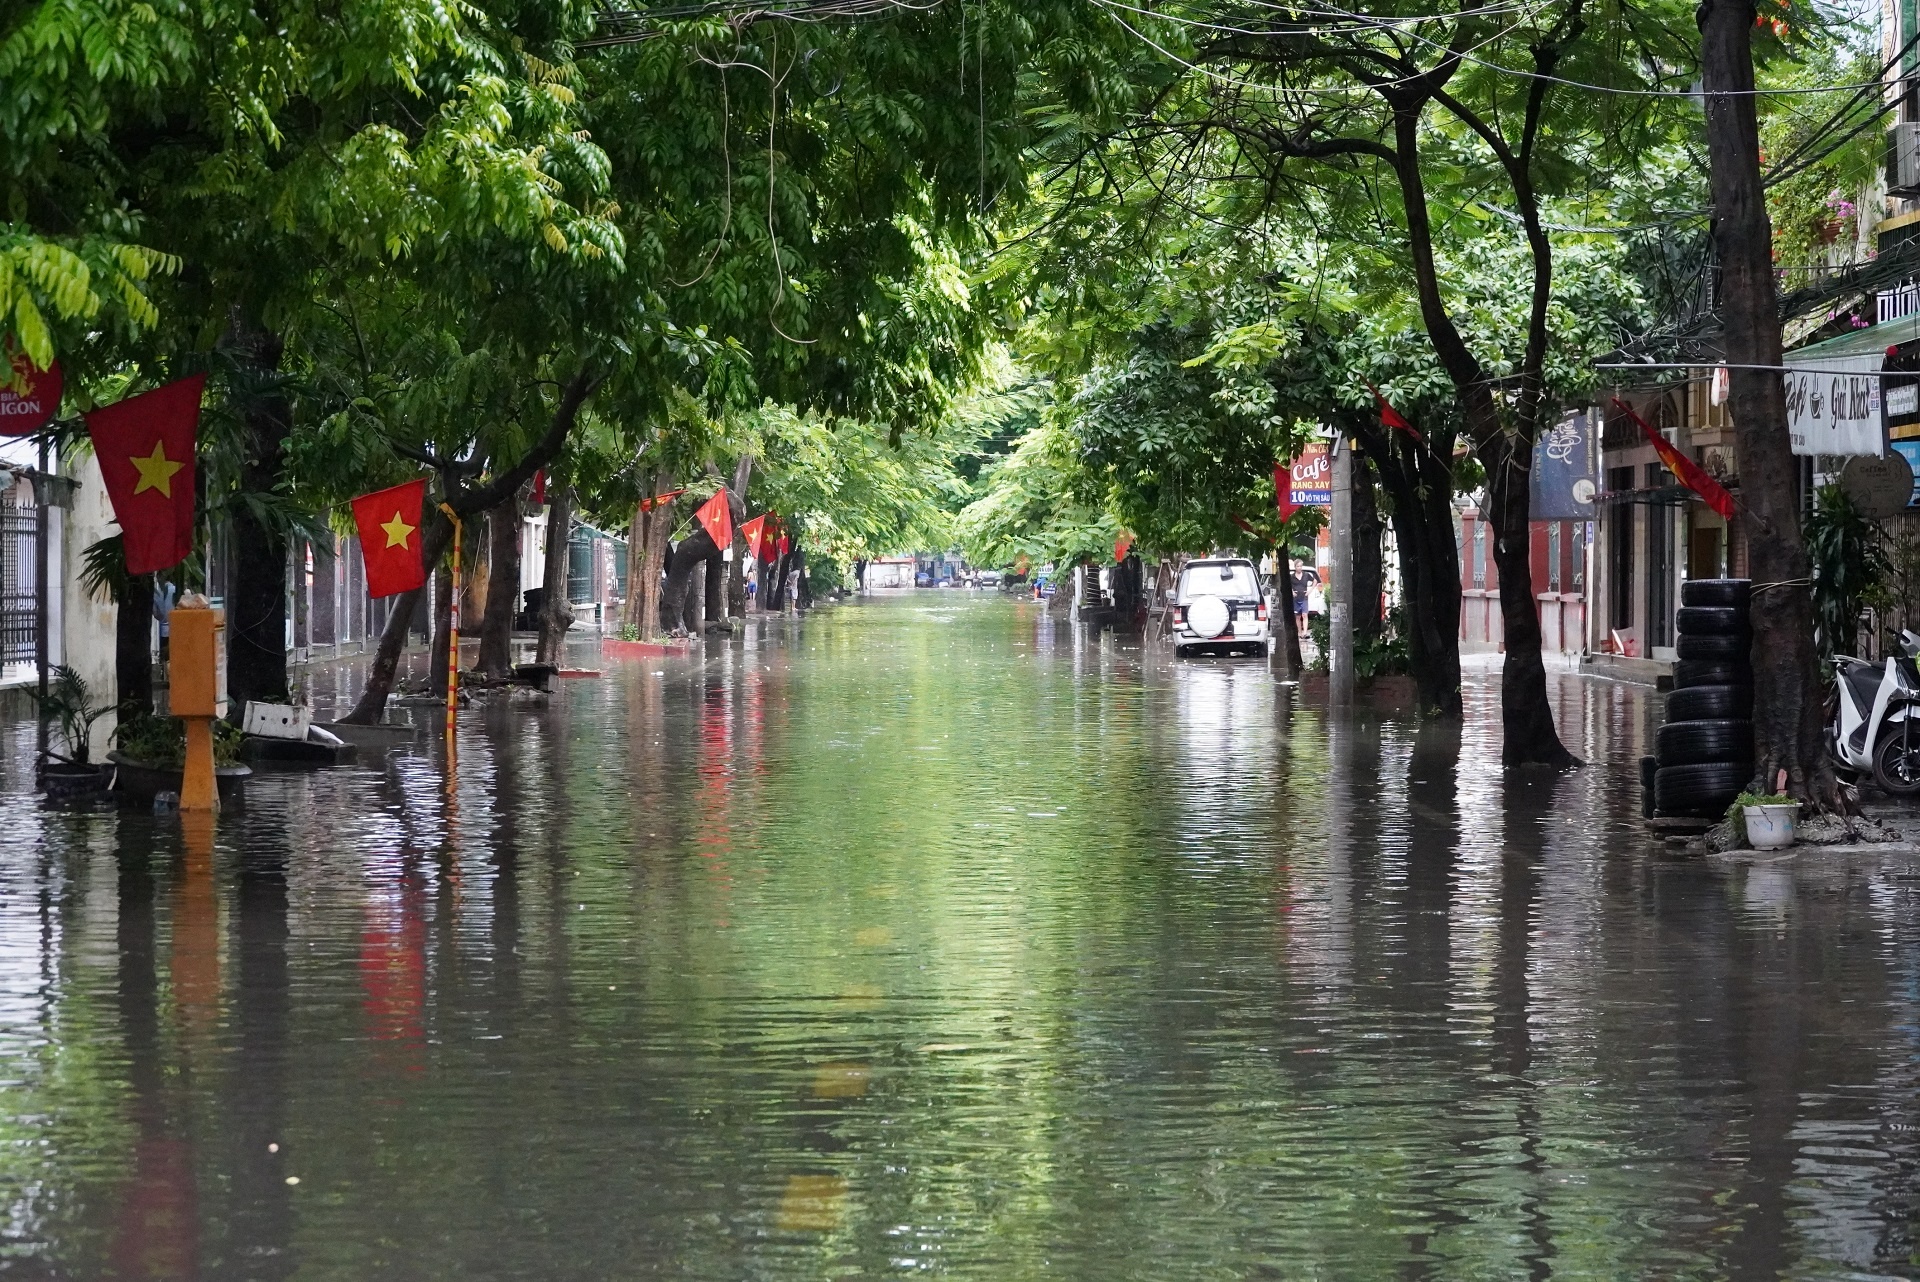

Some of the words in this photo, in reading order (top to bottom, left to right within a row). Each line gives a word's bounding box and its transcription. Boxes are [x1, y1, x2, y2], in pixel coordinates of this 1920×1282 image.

[1, 392, 19, 401] BIA
[0, 401, 40, 415] IGON
[1292, 455, 1329, 481] Café
[1292, 481, 1312, 489] RANG
[1315, 481, 1330, 489] XAY
[1291, 491, 1305, 503] 10
